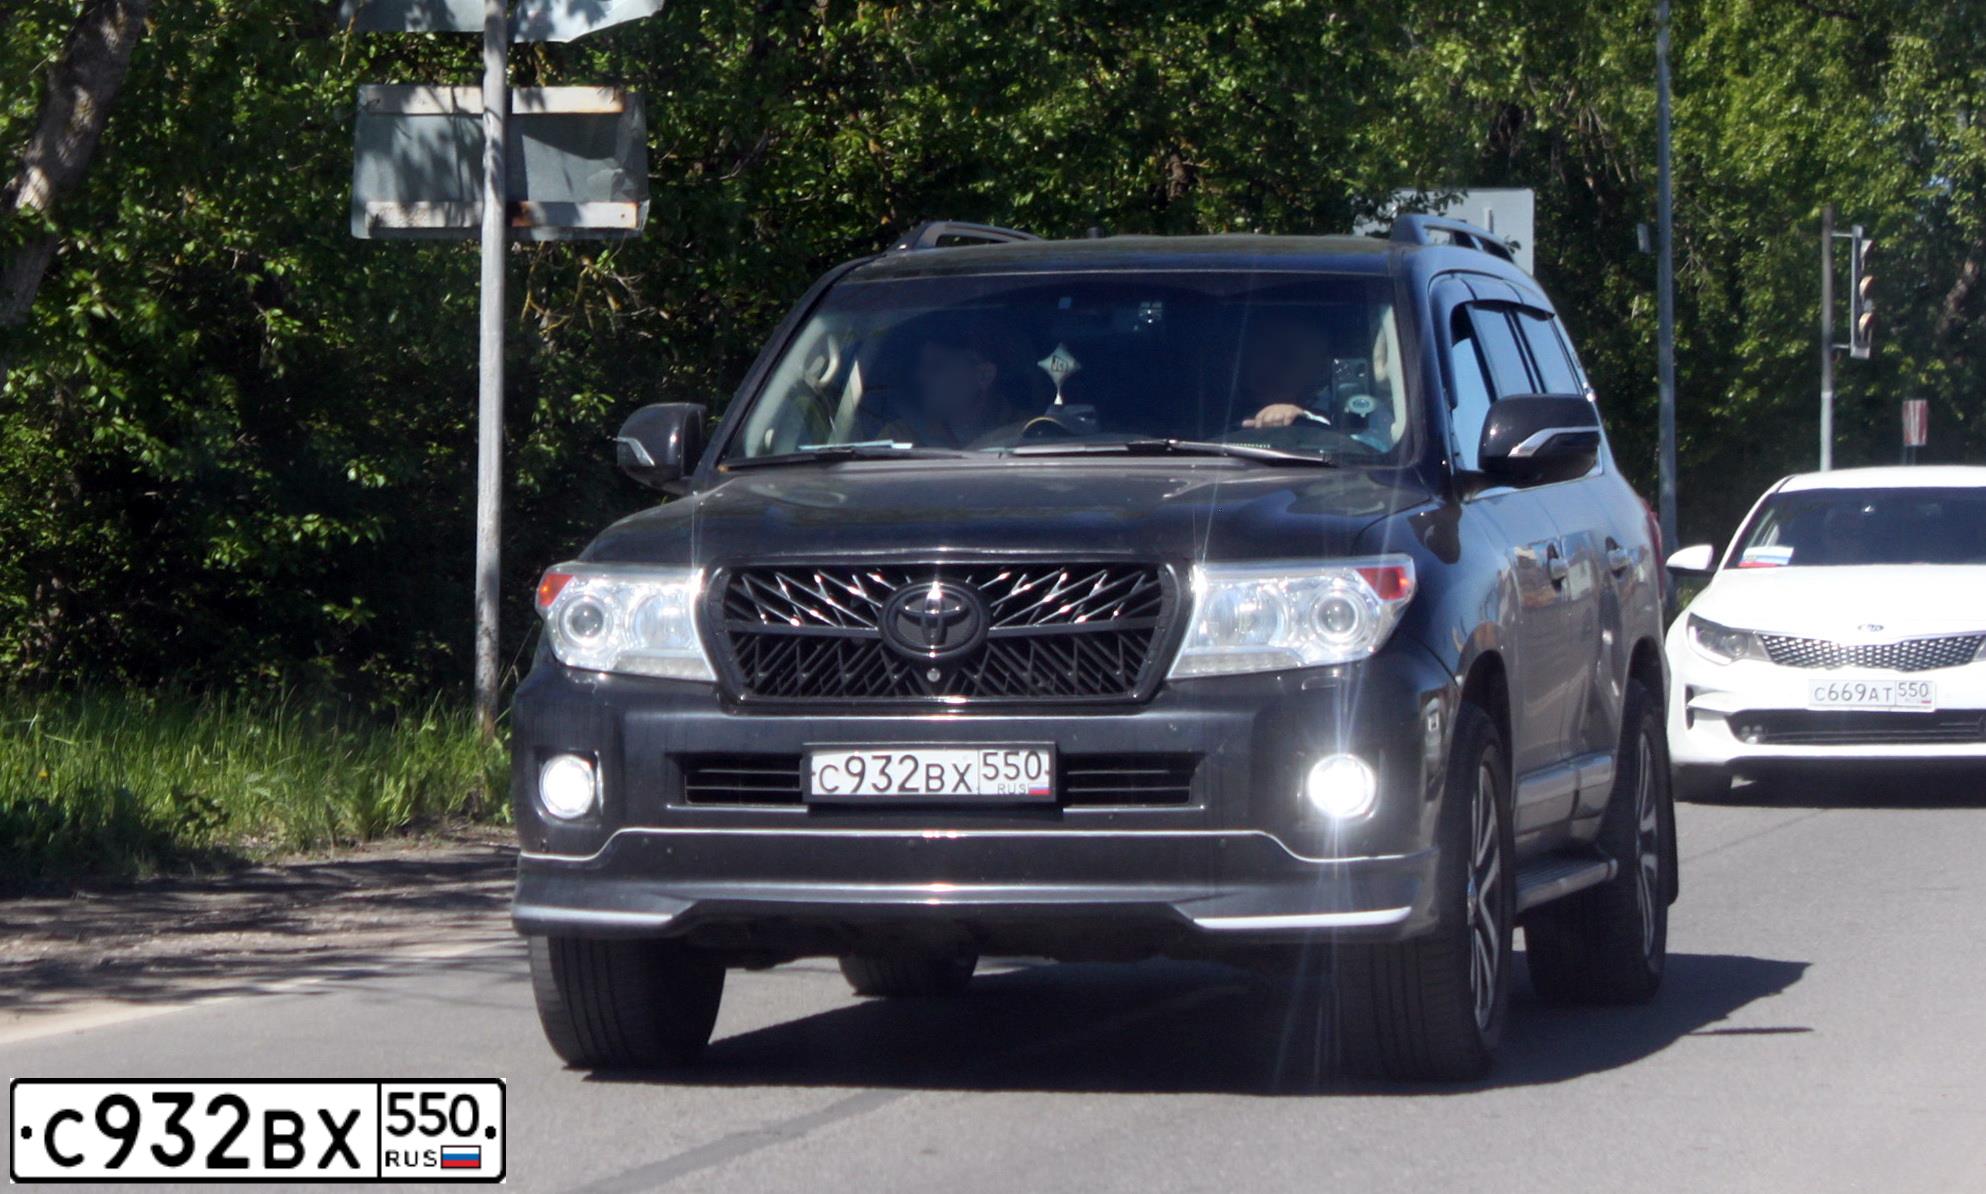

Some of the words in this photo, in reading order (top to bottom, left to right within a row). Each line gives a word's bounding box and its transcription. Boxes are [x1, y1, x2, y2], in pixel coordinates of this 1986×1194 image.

[1814, 683, 1893, 702] C669AT
[1897, 682, 1929, 698] 550
[818, 754, 973, 794] C932BX
[981, 751, 1043, 781] 550
[997, 783, 1027, 795] RUS
